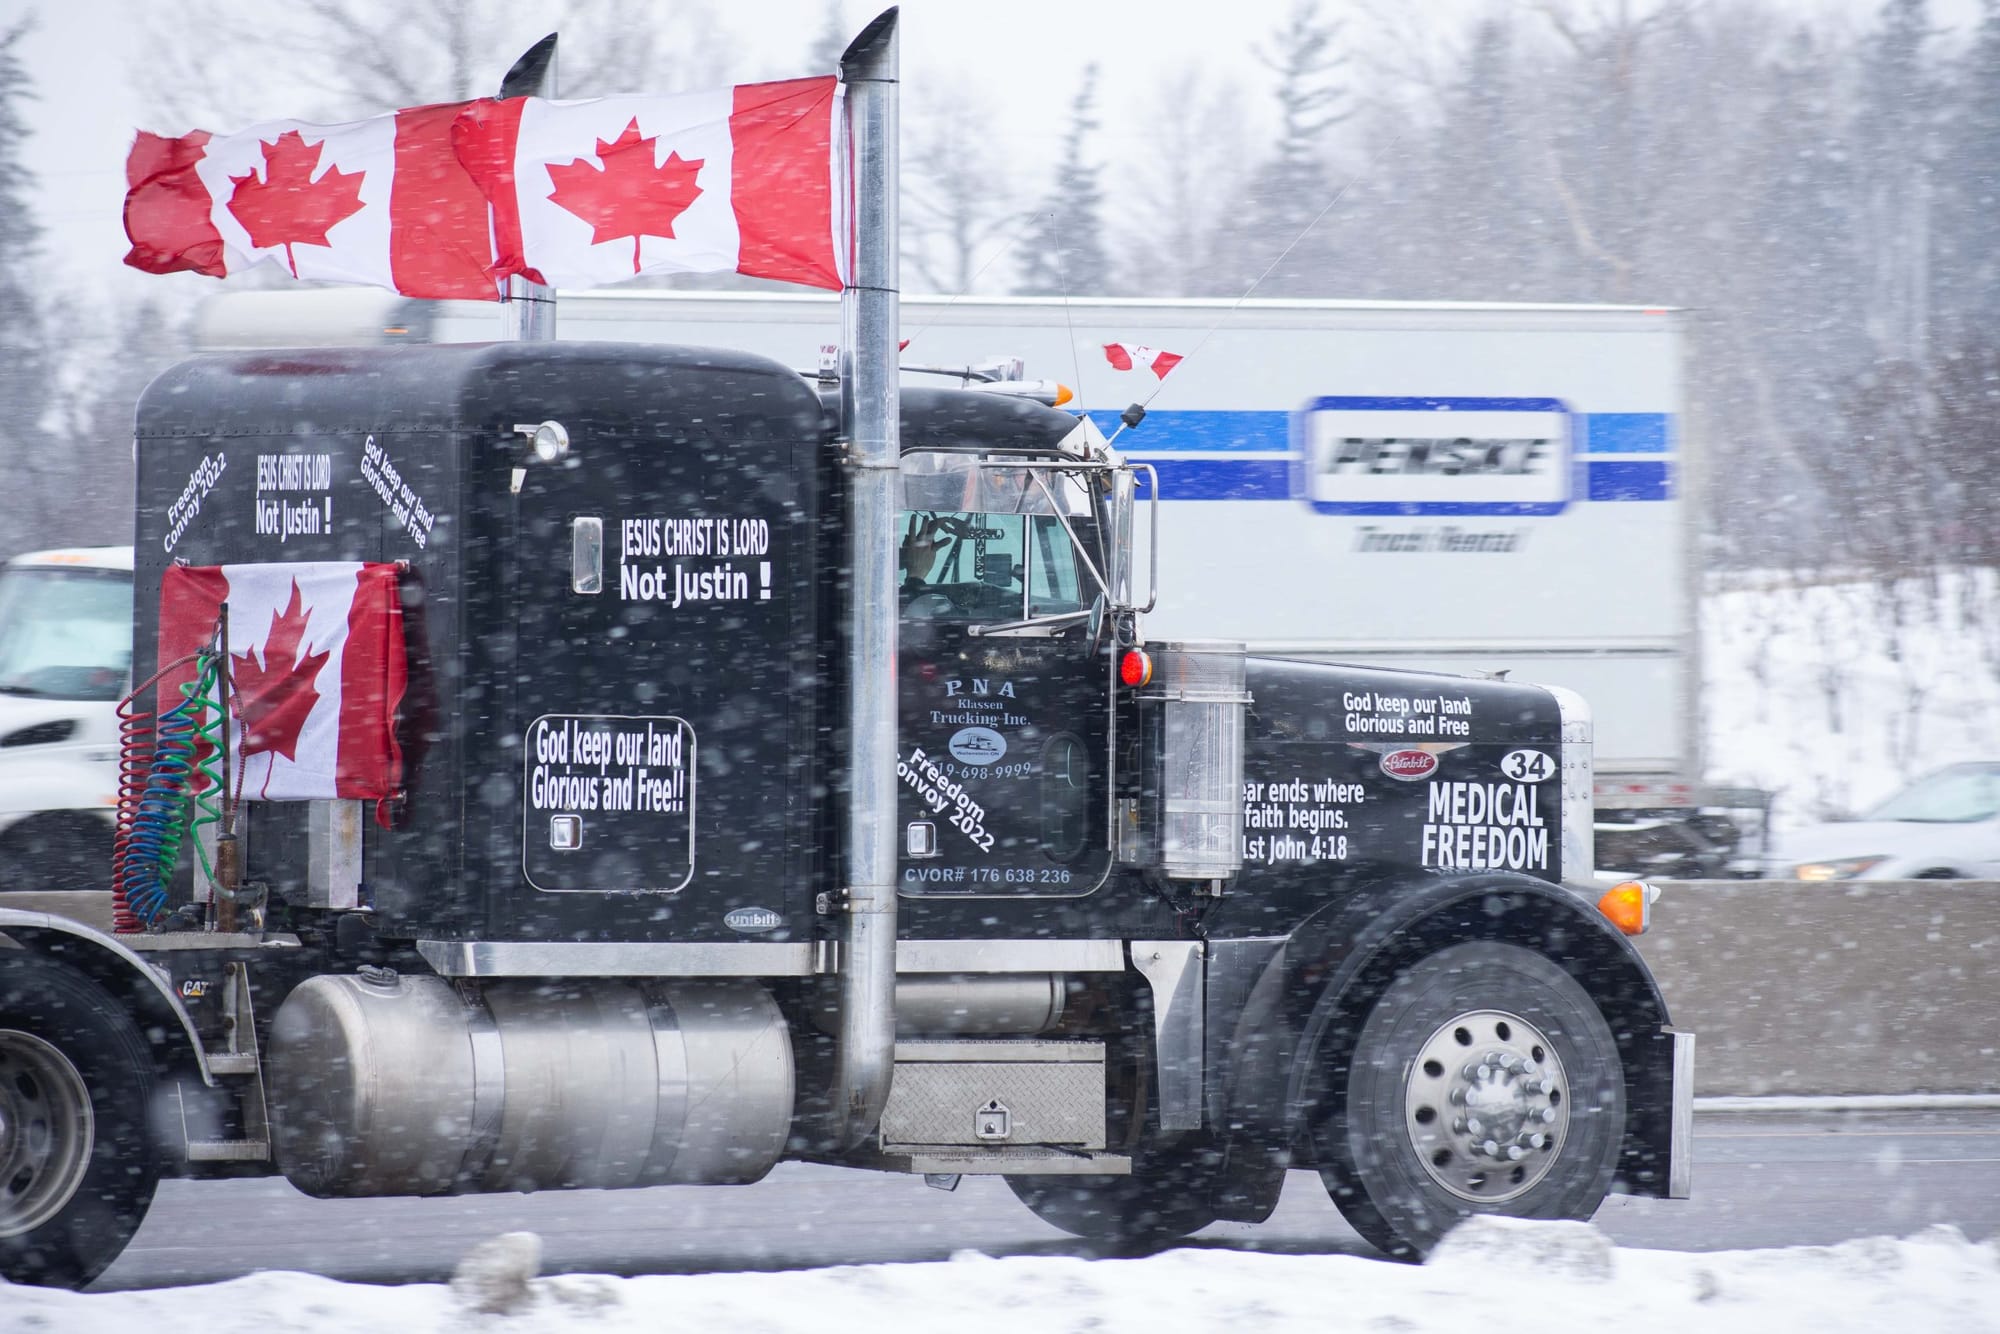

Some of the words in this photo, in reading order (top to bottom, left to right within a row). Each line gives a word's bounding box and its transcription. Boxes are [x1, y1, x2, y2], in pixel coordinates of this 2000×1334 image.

[167, 455, 211, 526] Freedom
[256, 454, 277, 499] JESUS
[278, 454, 303, 490] CHRIST
[304, 454, 311, 490] IS
[312, 454, 331, 490] LORD
[365, 434, 382, 466] God
[380, 453, 401, 493] keep
[401, 484, 416, 508] our
[414, 496, 434, 532] land
[164, 493, 200, 553] Convoy
[200, 452, 227, 498] 2022
[256, 499, 279, 534] Not
[281, 498, 320, 543] Justin
[360, 455, 393, 506] Glorious
[392, 498, 409, 527] and
[407, 514, 426, 550] Free
[620, 519, 660, 564] JESUS
[665, 519, 713, 556] CHRIST
[717, 519, 729, 556] IS
[733, 519, 769, 556] LORD
[620, 564, 667, 600] Not
[672, 562, 748, 609] Justin
[759, 561, 771, 600] !
[930, 710, 998, 728] Trucking
[1003, 712, 1032, 726] Inc.
[958, 698, 1004, 710] Klassen
[1343, 692, 1372, 712] God
[1374, 692, 1410, 717] keep
[1413, 698, 1437, 714] our
[1439, 696, 1472, 715] land
[1345, 713, 1405, 734] Glorious
[1408, 715, 1435, 735] and
[1438, 716, 1470, 736] Free
[536, 719, 569, 764] God
[573, 719, 612, 776] keep
[616, 731, 644, 766] our
[647, 722, 682, 767] land
[1389, 755, 1432, 770] Peterbilt
[1510, 752, 1546, 780] 34
[532, 764, 598, 810] Glorious
[602, 767, 633, 811] and
[637, 769, 684, 812] Free!!
[897, 752, 949, 813] onvoy
[949, 807, 995, 853] 2022
[910, 747, 985, 823] Freedom
[1268, 777, 1309, 803] ends
[1313, 778, 1365, 803] where
[1428, 781, 1544, 827] MEDICAL
[1244, 803, 1283, 828] faith
[1289, 803, 1348, 834] begins.
[1268, 834, 1306, 865] John
[1311, 835, 1348, 860] 4:18
[1421, 825, 1548, 870] FREEDOM
[905, 868, 964, 882] CVOR#
[971, 868, 1000, 882] 176
[1005, 869, 1035, 883] 638
[1040, 870, 1071, 884] 236
[730, 913, 775, 925] unibilt
[183, 980, 209, 997] CAT
